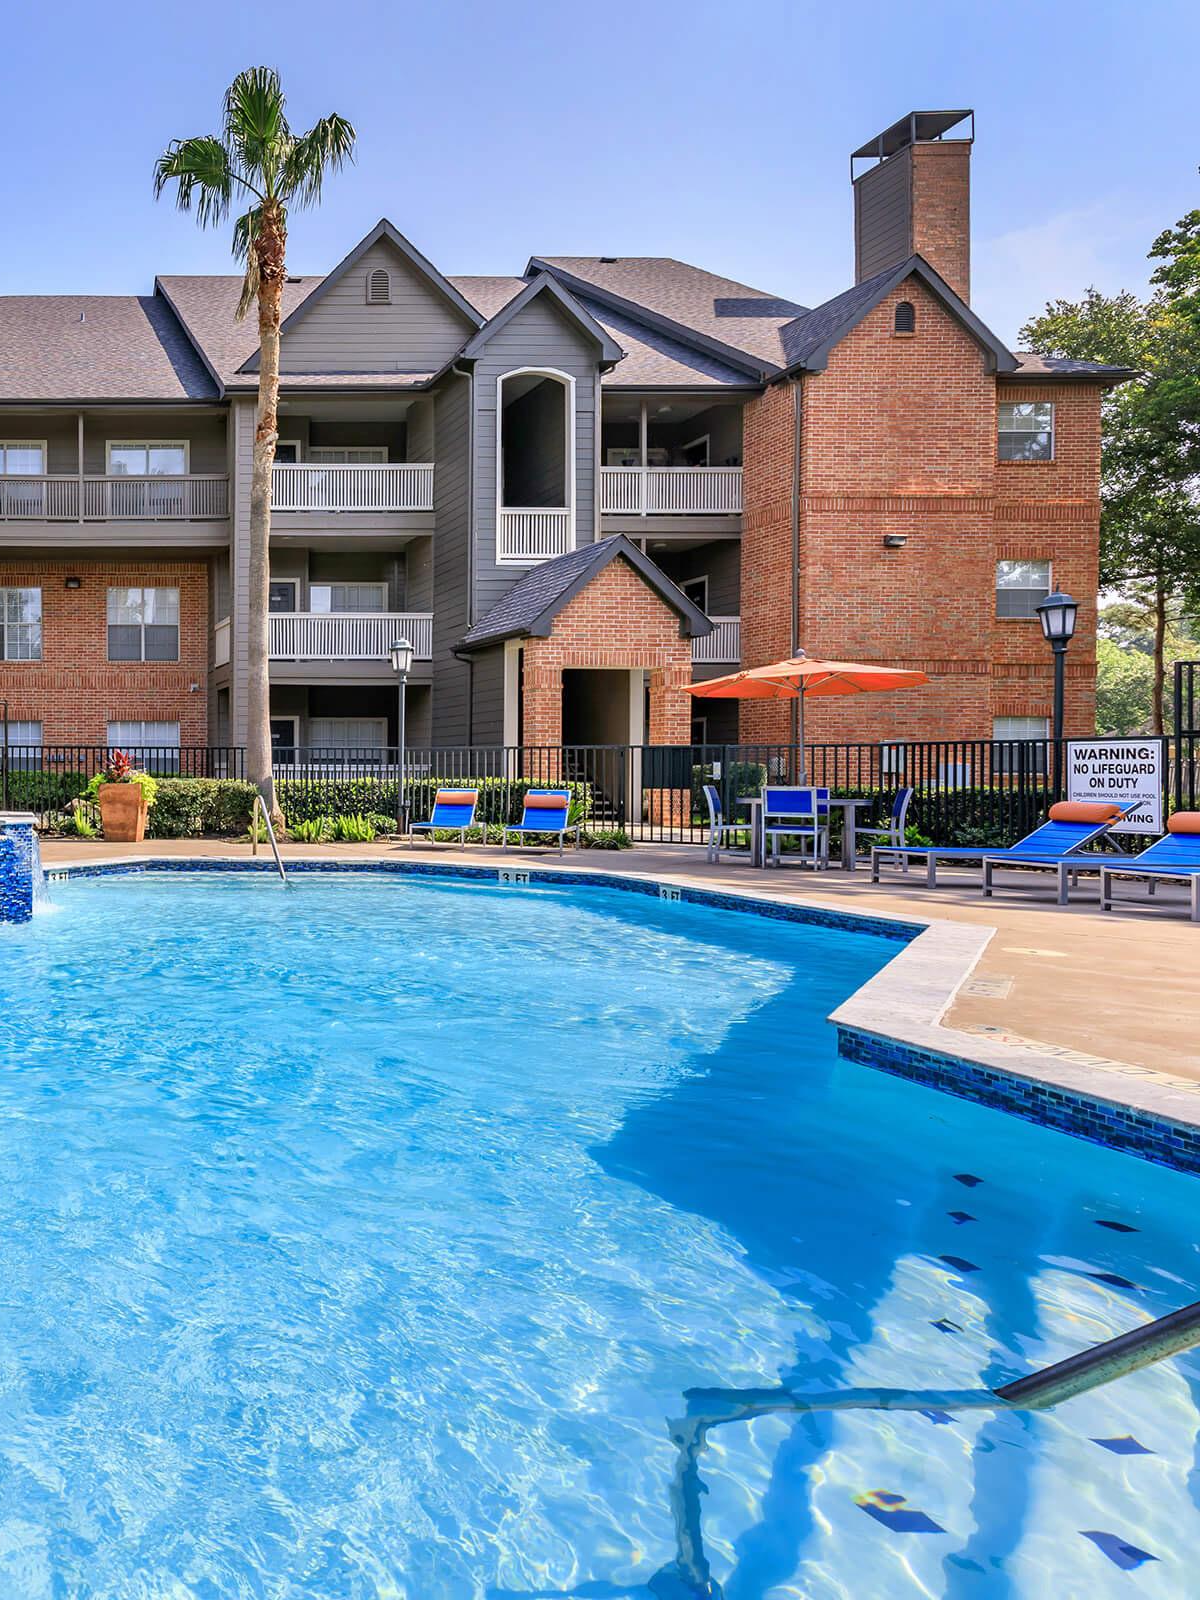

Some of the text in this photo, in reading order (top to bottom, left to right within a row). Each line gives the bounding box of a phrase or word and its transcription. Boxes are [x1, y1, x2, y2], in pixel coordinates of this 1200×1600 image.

[1074, 748, 1155, 760] WARNING:
[1073, 764, 1155, 775] NO LIFEGUARD
[1089, 778, 1138, 788] ON DUTY
[502, 872, 529, 882] 3 FT
[671, 890, 679, 901] FT
